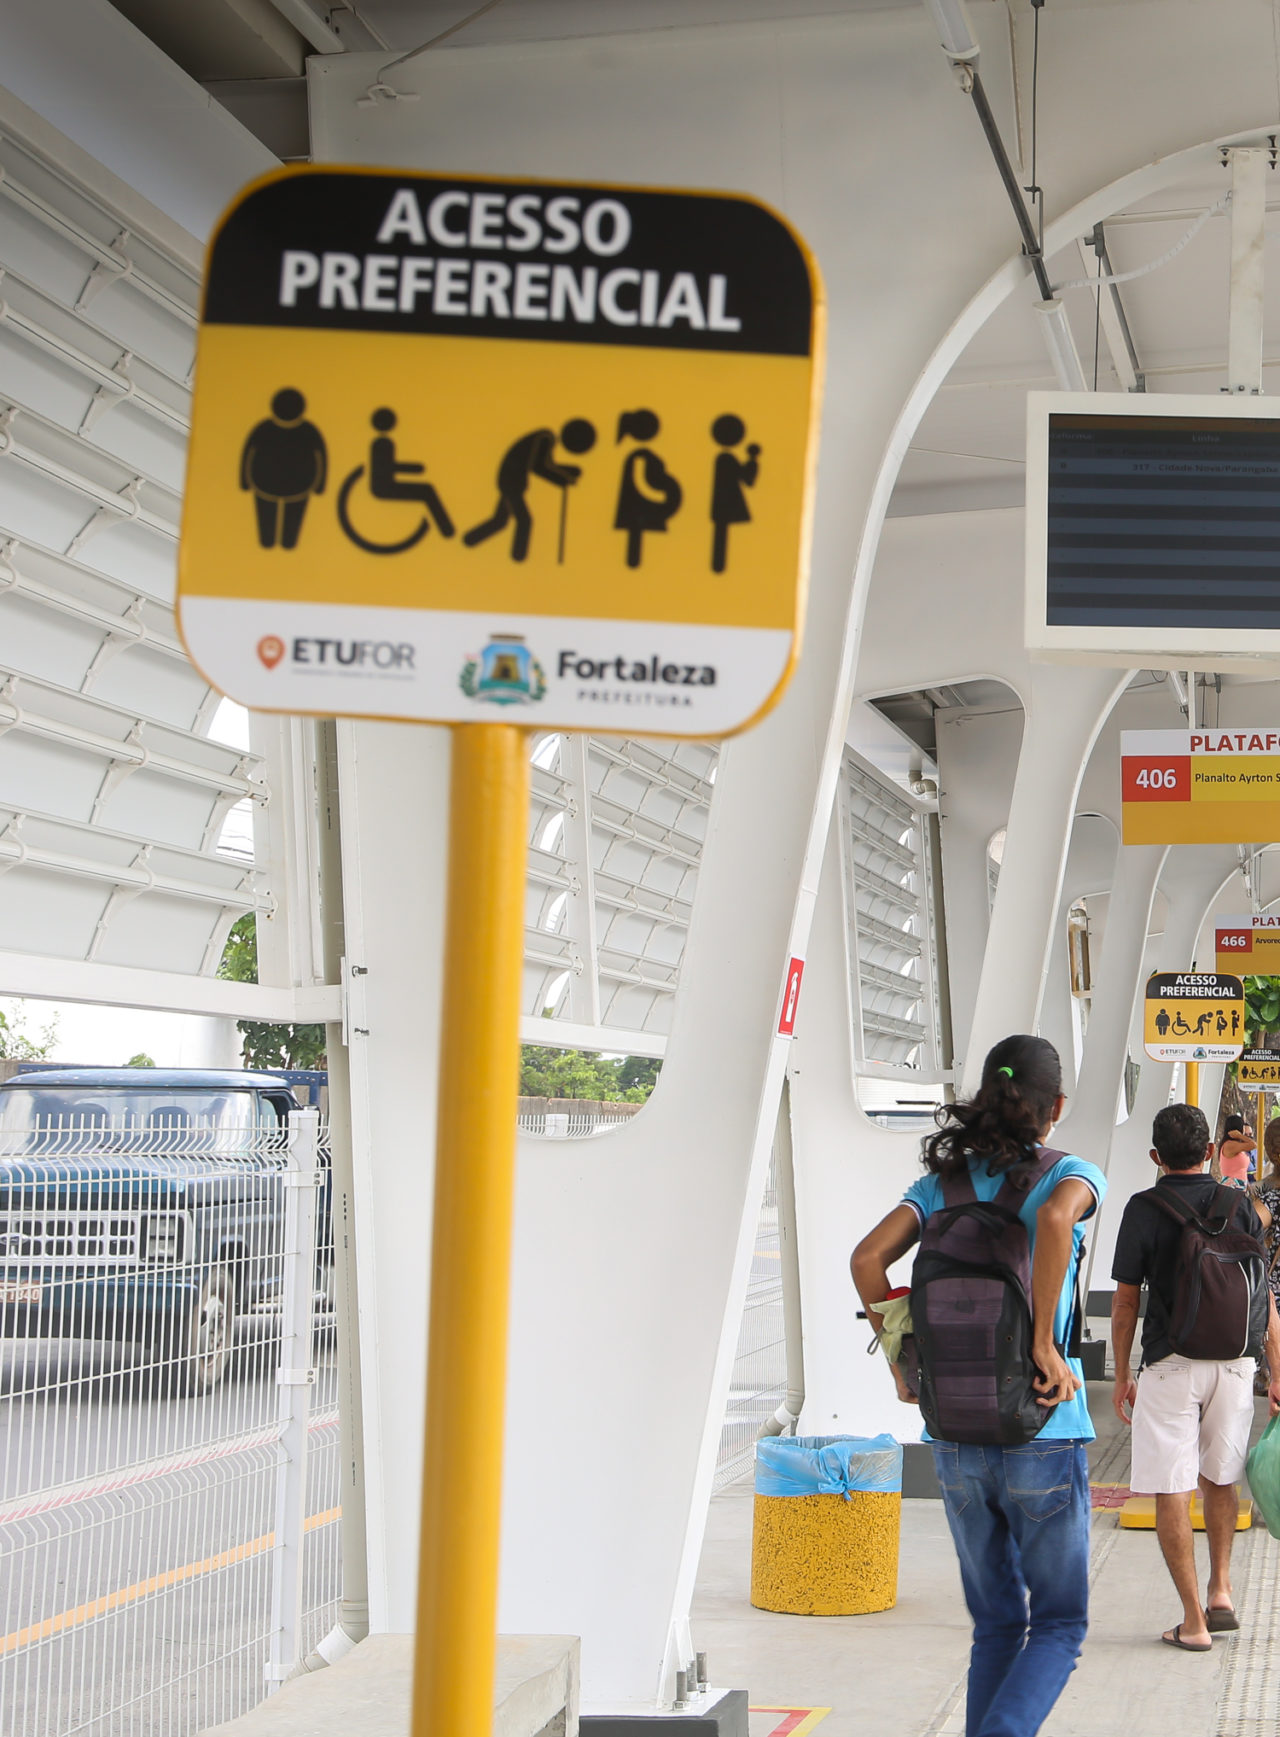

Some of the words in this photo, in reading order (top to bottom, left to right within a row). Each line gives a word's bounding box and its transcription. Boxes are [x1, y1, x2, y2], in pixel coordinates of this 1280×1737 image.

[377, 188, 632, 257] ACESSO
[280, 250, 741, 332] PREFERENCIAL
[292, 637, 415, 669] ETUFOR
[558, 650, 717, 686] Fortaleza
[577, 689, 693, 706] PREFEITURA
[1136, 768, 1177, 789] 406
[1195, 773, 1236, 783] Planalto
[1239, 773, 1273, 784] Ayrton
[1221, 936, 1246, 946] 466
[1175, 975, 1217, 985] ACESSO
[1160, 986, 1236, 997] PREFERENCIAL
